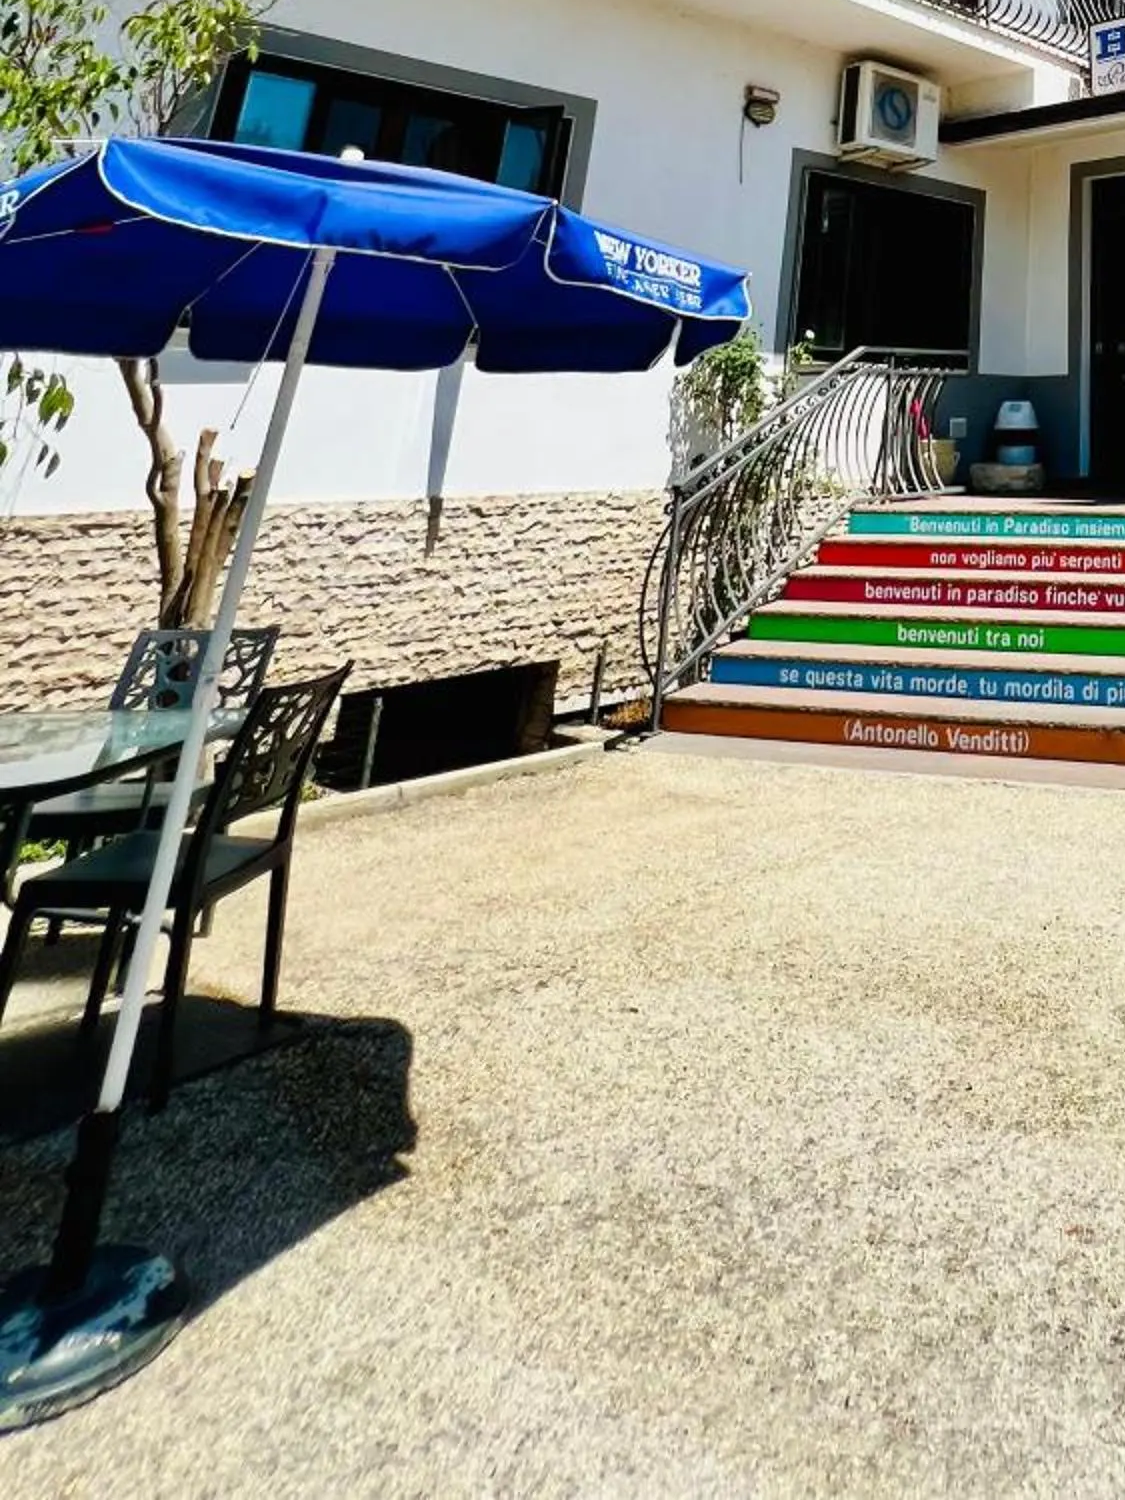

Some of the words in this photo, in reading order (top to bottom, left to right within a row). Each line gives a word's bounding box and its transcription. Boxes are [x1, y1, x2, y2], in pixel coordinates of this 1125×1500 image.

[634, 245, 701, 287] YORKER
[986, 517, 999, 533] in
[1003, 517, 1070, 535] Paradiso
[930, 552, 956, 565] non
[961, 550, 1027, 569] vogliamo
[1059, 553, 1122, 570] serpenti
[865, 582, 942, 600] benvenuti
[947, 583, 961, 601] in
[967, 586, 1039, 605] paradiso
[897, 623, 979, 645] benvenuti
[986, 629, 1011, 647] tra
[1017, 629, 1044, 648] noi
[779, 668, 799, 683] se
[805, 669, 864, 688] questa
[871, 670, 904, 691] vita
[979, 677, 997, 695] tu
[1004, 679, 1075, 700] mordila
[1082, 680, 1099, 701] di
[843, 719, 938, 747] (Antonello
[945, 727, 1030, 753] Venditti)
